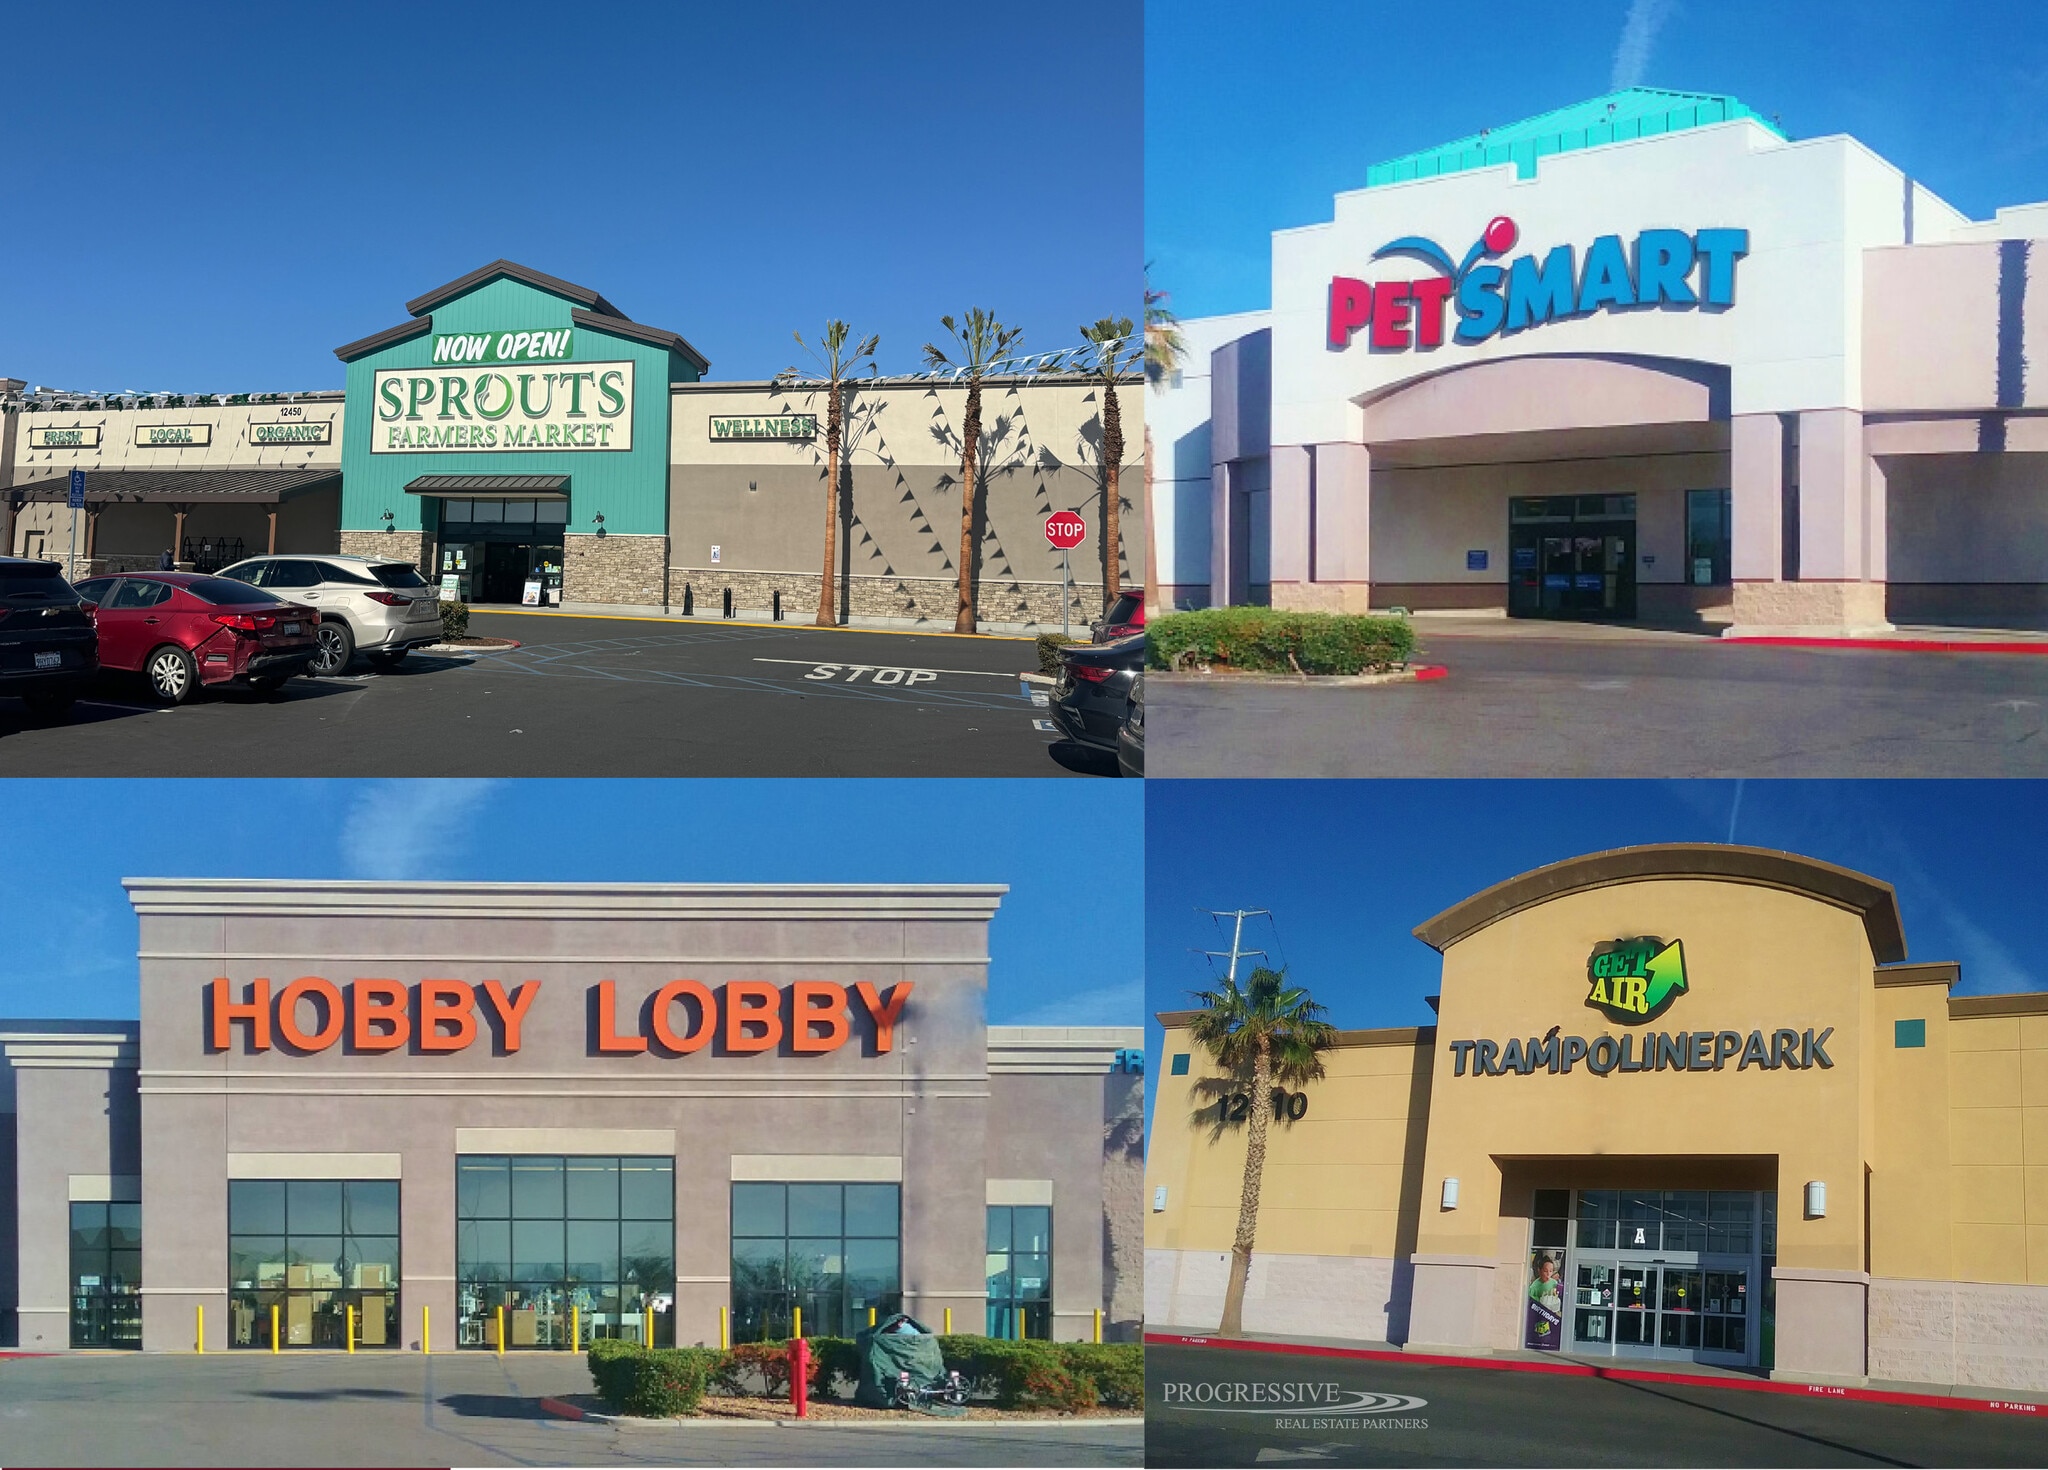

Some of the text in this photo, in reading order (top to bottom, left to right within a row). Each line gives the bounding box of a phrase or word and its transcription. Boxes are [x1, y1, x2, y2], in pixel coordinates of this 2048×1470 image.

[1328, 227, 1749, 352] PETSMART
[433, 329, 571, 362] NOW OPEN!
[378, 370, 625, 420] SPROUTS
[280, 407, 302, 417] 12450
[43, 430, 83, 444] FRESH
[149, 428, 193, 442] LOCAL
[256, 425, 322, 441] ORGANIC
[387, 423, 614, 448] FARMERS MARKET
[713, 419, 812, 436] WELLNESS
[1047, 522, 1083, 538] STOP
[804, 664, 938, 686] STOP
[1592, 944, 1655, 978] GET
[1588, 976, 1649, 1015] AIR
[207, 976, 914, 1055] HOBBY LOBBY
[1217, 1091, 1308, 1121] 1210
[1634, 1227, 1646, 1244] A
[1531, 1303, 1560, 1326] BIRTHDAYS
[1808, 1385, 1846, 1395] FIRE LANE
[1989, 1401, 2037, 1412] NO PARKING
